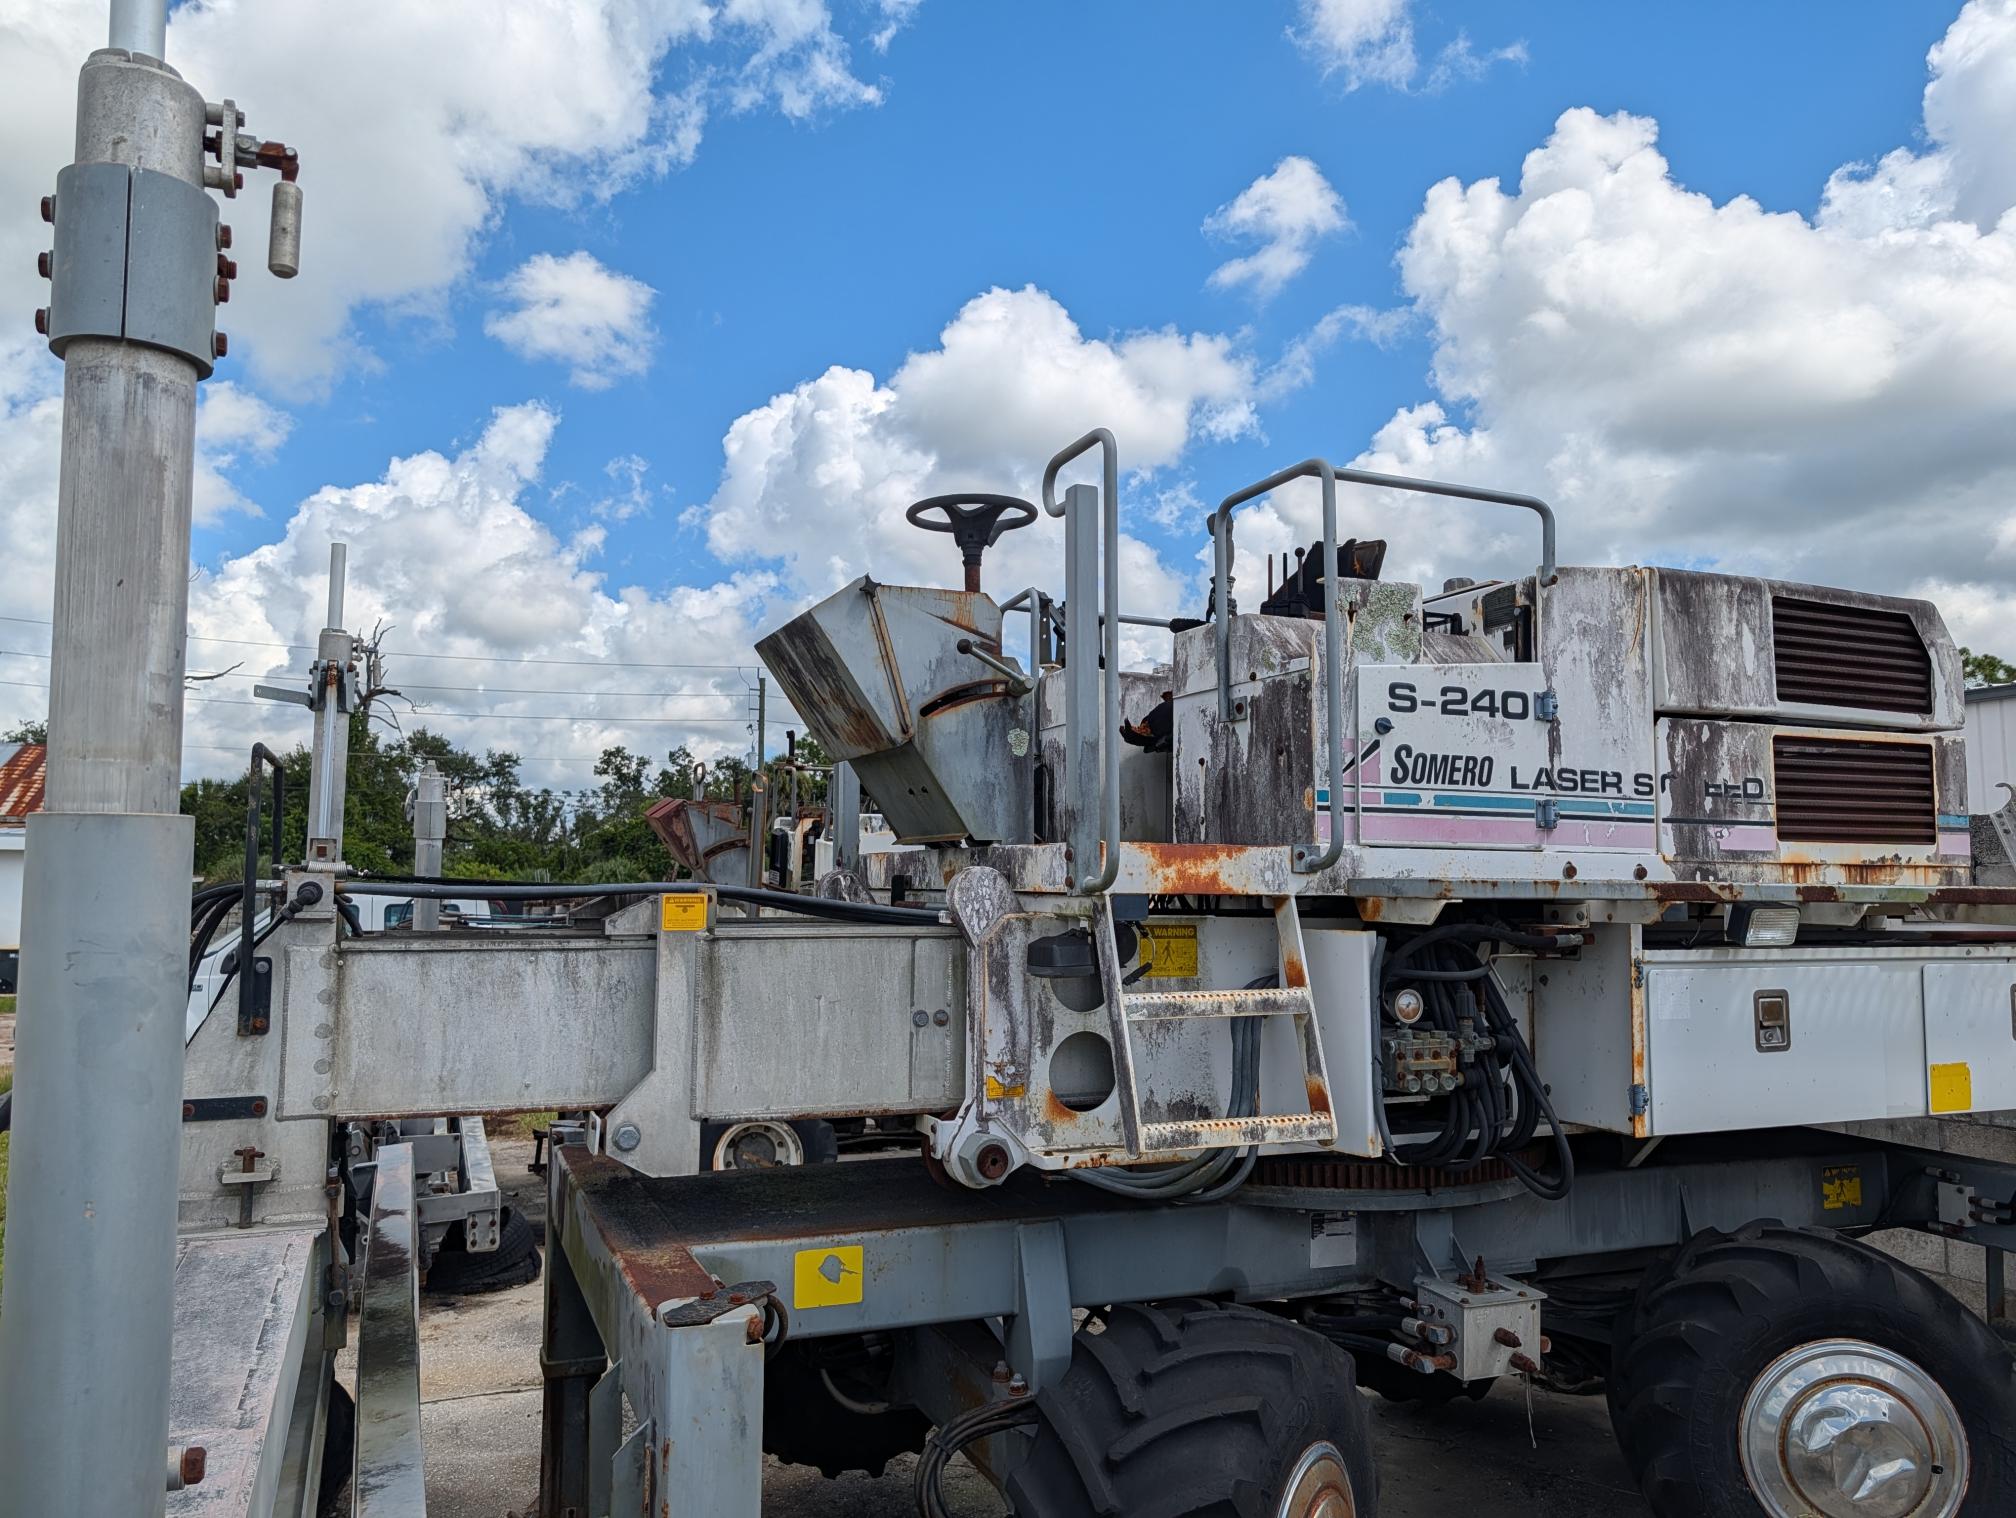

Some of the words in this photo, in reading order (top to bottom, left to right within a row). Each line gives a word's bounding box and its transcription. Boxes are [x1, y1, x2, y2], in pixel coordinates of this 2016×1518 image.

[1388, 682, 1529, 720] S-240
[1391, 744, 1494, 787] SOMERO
[1510, 766, 1623, 795] LASER
[1153, 927, 1195, 937] WARNING
